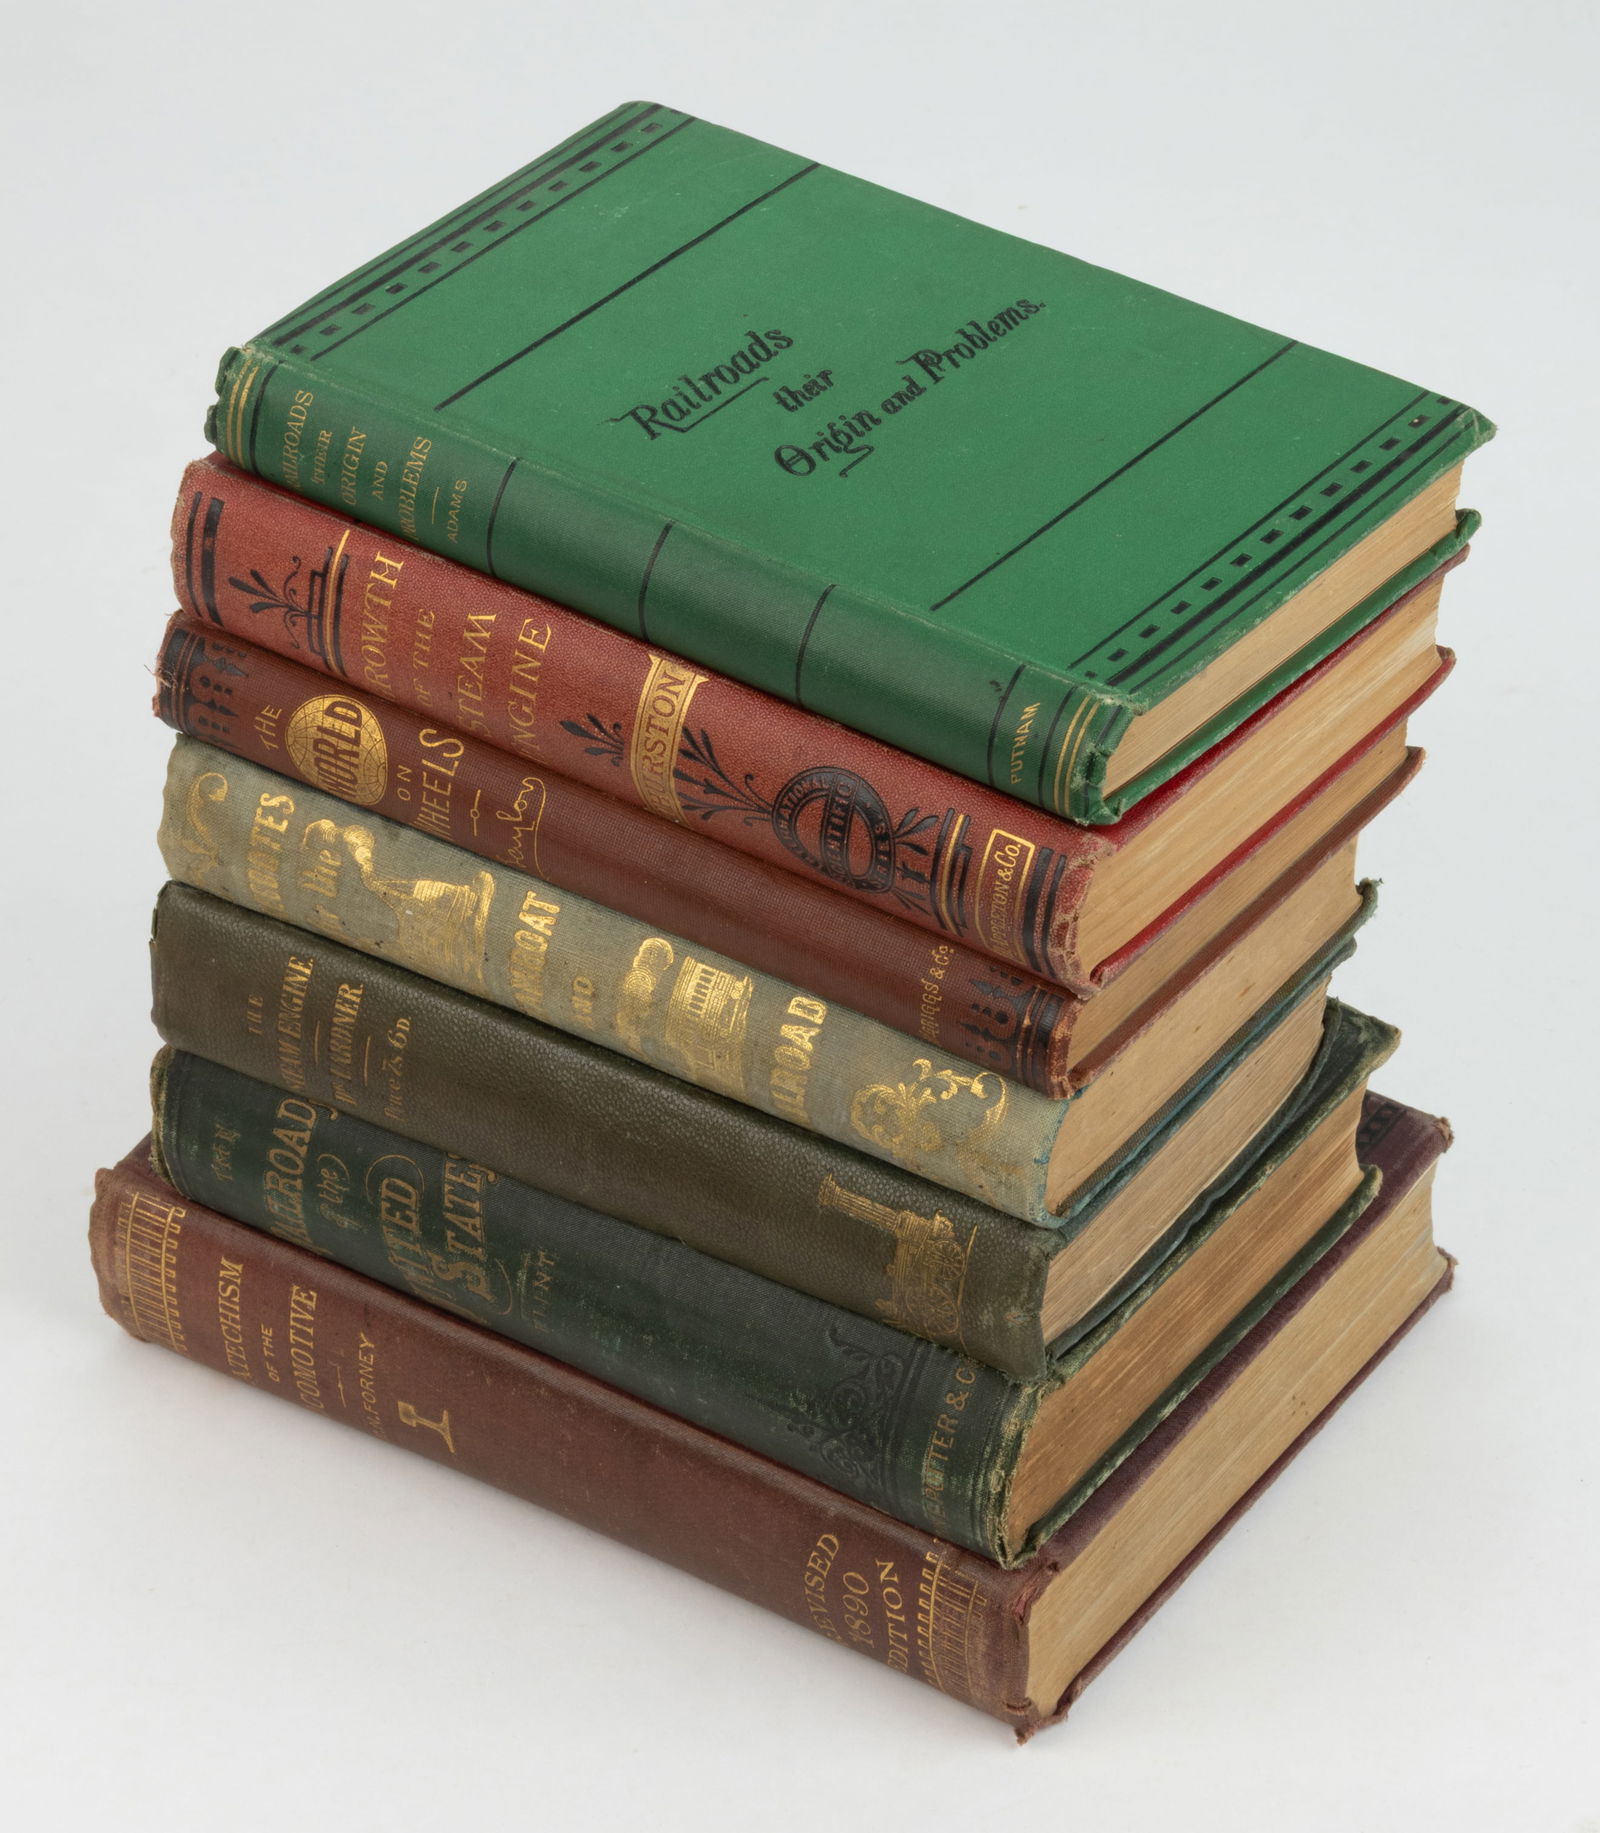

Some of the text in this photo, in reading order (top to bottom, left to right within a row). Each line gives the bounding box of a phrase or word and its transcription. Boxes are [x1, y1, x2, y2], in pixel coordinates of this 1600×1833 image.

[606, 328, 793, 440] Railroads
[773, 369, 835, 412] their
[774, 297, 1047, 477] Origin and Problems.
[340, 425, 368, 506] ORIGIN
[371, 459, 389, 502] AND
[447, 479, 468, 544] ADAMS
[361, 551, 404, 698] ROWTH
[413, 607, 436, 672] THE
[253, 704, 283, 752] THE
[1010, 702, 1041, 785] PUTNAM
[397, 764, 414, 801] ON
[277, 955, 315, 1040] ENGINE.
[929, 967, 945, 980] &
[260, 1322, 281, 1384] OF THE
[945, 1391, 967, 1412] &
[804, 1533, 841, 1640] EVISED
[842, 1570, 875, 1649] 1890
